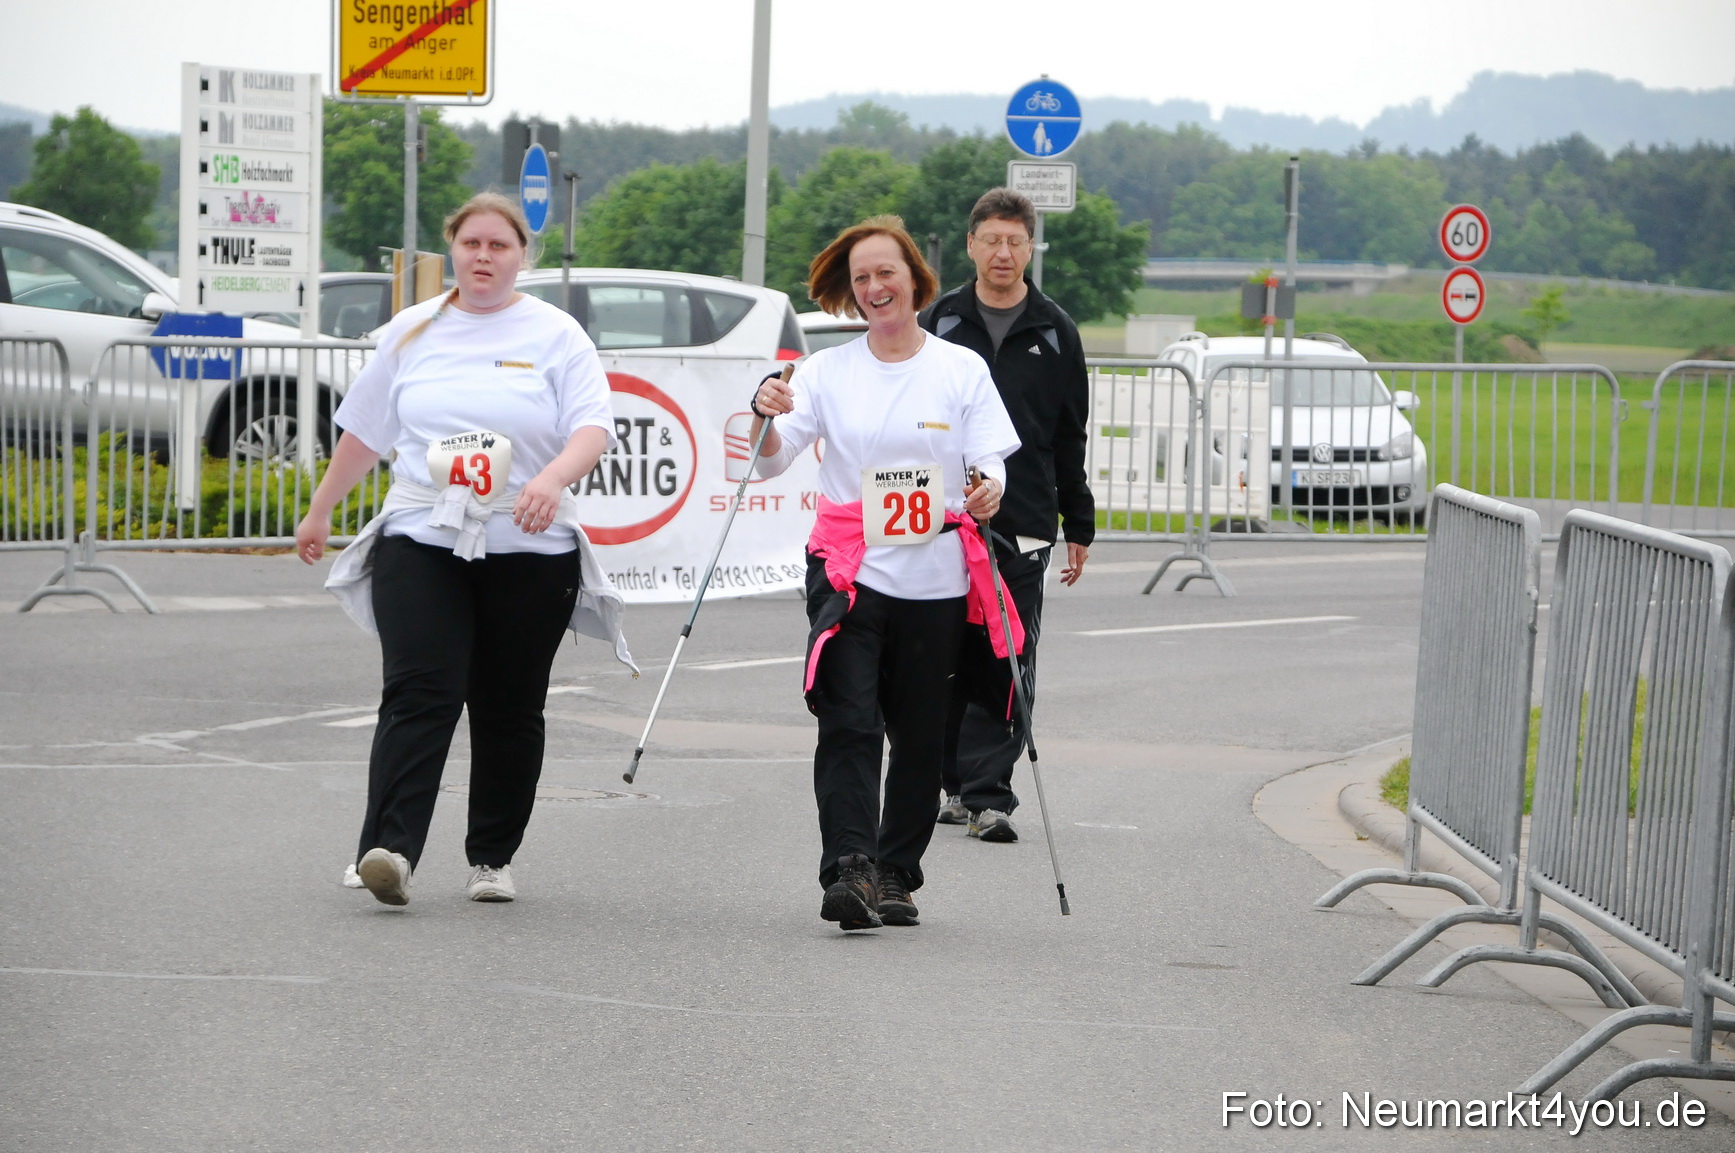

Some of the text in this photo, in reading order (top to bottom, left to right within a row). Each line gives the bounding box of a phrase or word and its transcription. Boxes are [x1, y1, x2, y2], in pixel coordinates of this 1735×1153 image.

[353, 0, 473, 31] Sengenthal
[369, 34, 457, 54] am Anger
[242, 72, 295, 92] HOLZAMMER
[349, 65, 375, 79] Kreis
[381, 65, 434, 80] Neumarkt
[242, 112, 294, 132] HOLZAMMER
[212, 154, 240, 184] SHB
[1452, 221, 1479, 246] 60
[211, 236, 255, 265] THULE
[440, 434, 478, 446] MEYER
[603, 417, 672, 455] RT &
[440, 442, 479, 451] WERBUNG
[449, 453, 492, 496] 43
[875, 471, 913, 481] MEYER
[875, 480, 914, 488] WERBUNG
[710, 495, 785, 511] SEAT
[801, 491, 824, 510] KI
[883, 490, 931, 536] 28
[607, 566, 658, 590] enthal
